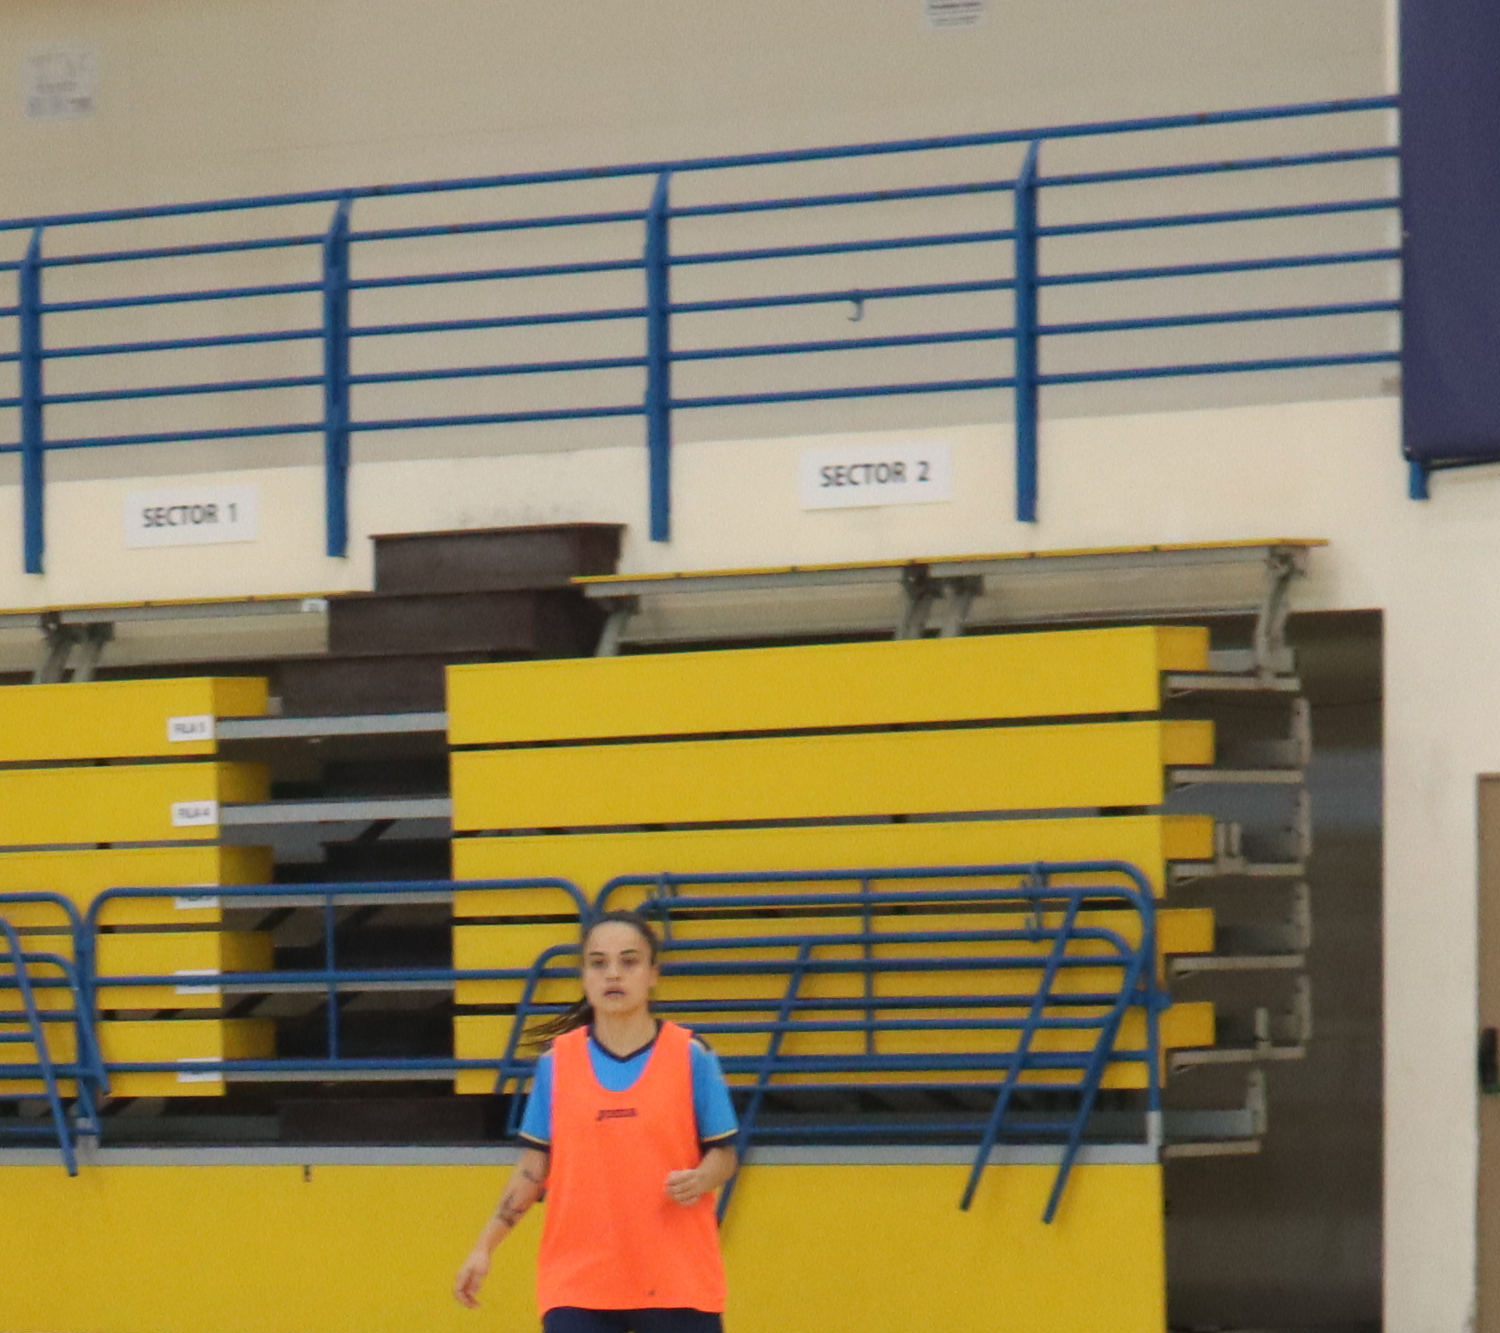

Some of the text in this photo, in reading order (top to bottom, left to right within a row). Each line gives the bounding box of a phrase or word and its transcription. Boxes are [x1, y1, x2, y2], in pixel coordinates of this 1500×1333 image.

[818, 460, 929, 488] SECTOR 2
[142, 502, 238, 528] SECTOR 1
